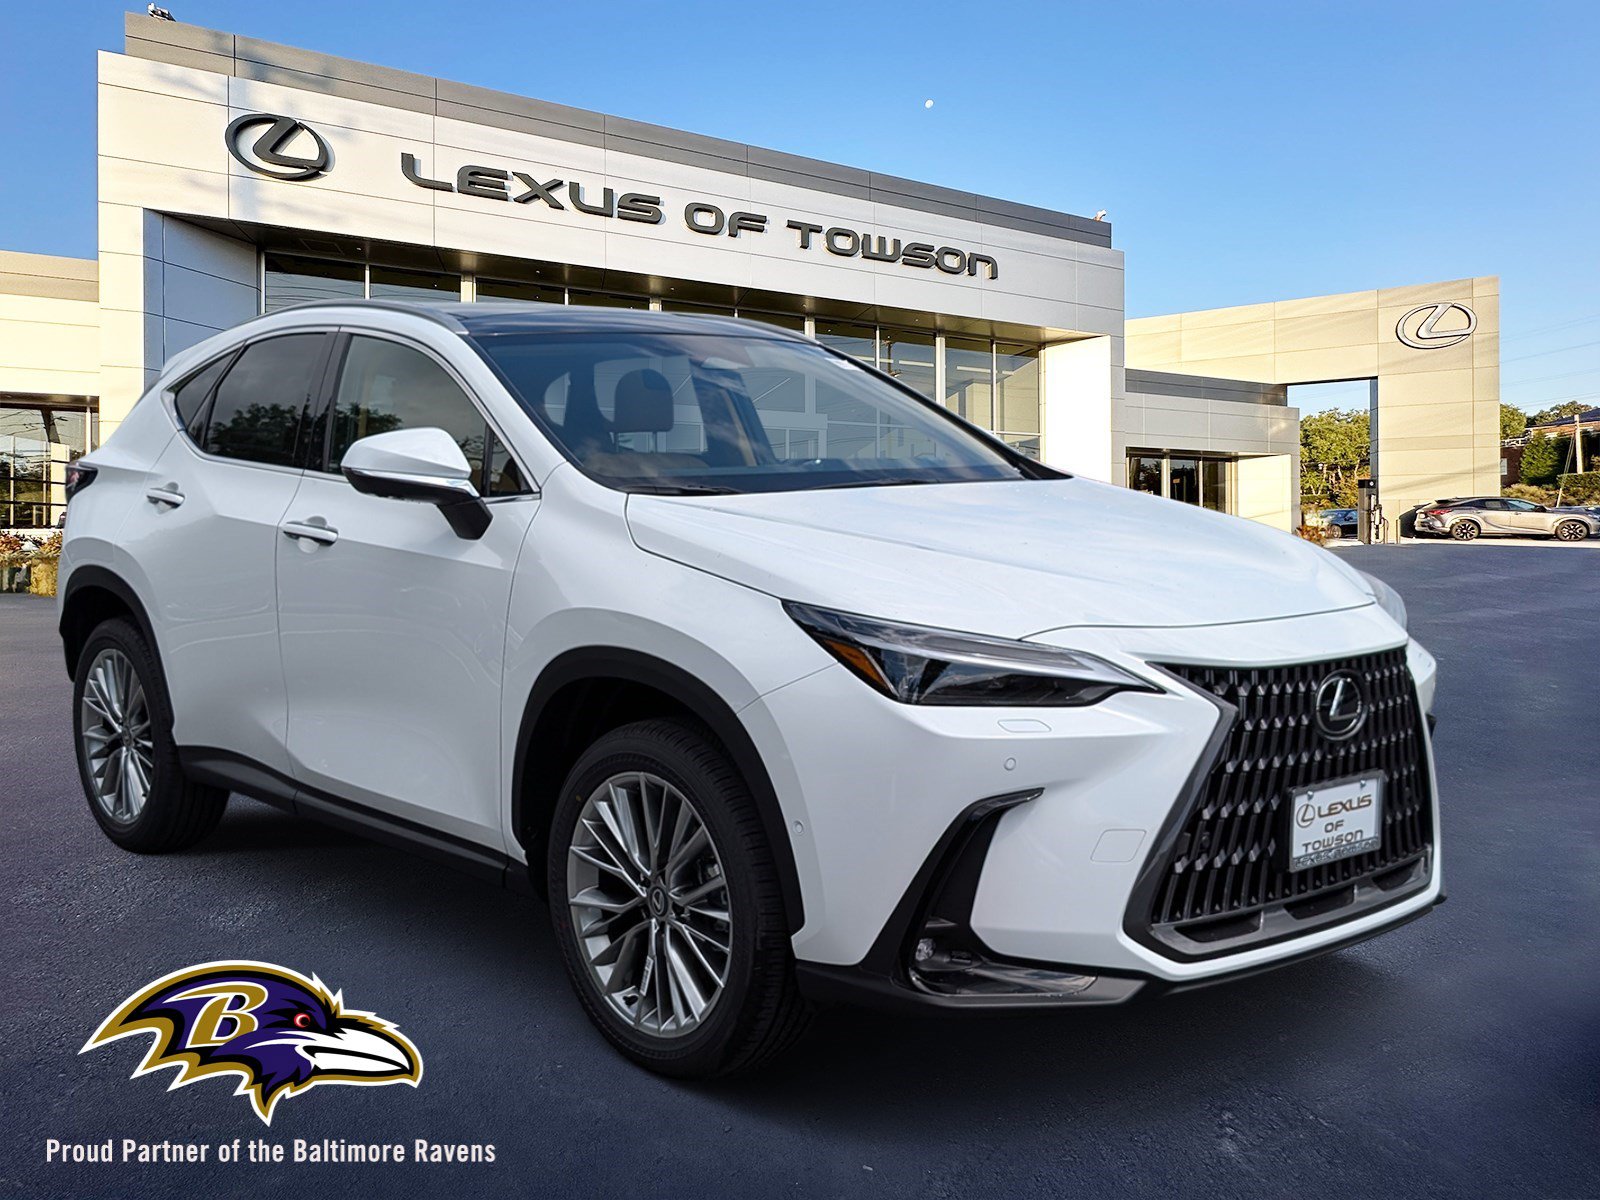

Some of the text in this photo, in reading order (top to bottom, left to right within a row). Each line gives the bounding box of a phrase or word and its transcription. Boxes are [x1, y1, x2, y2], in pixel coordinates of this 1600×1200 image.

[401, 152, 999, 280] LEXUS OF TOWSON
[1317, 794, 1372, 818] LEXUS
[1324, 820, 1344, 834] OF
[1302, 829, 1364, 853] TOWSON
